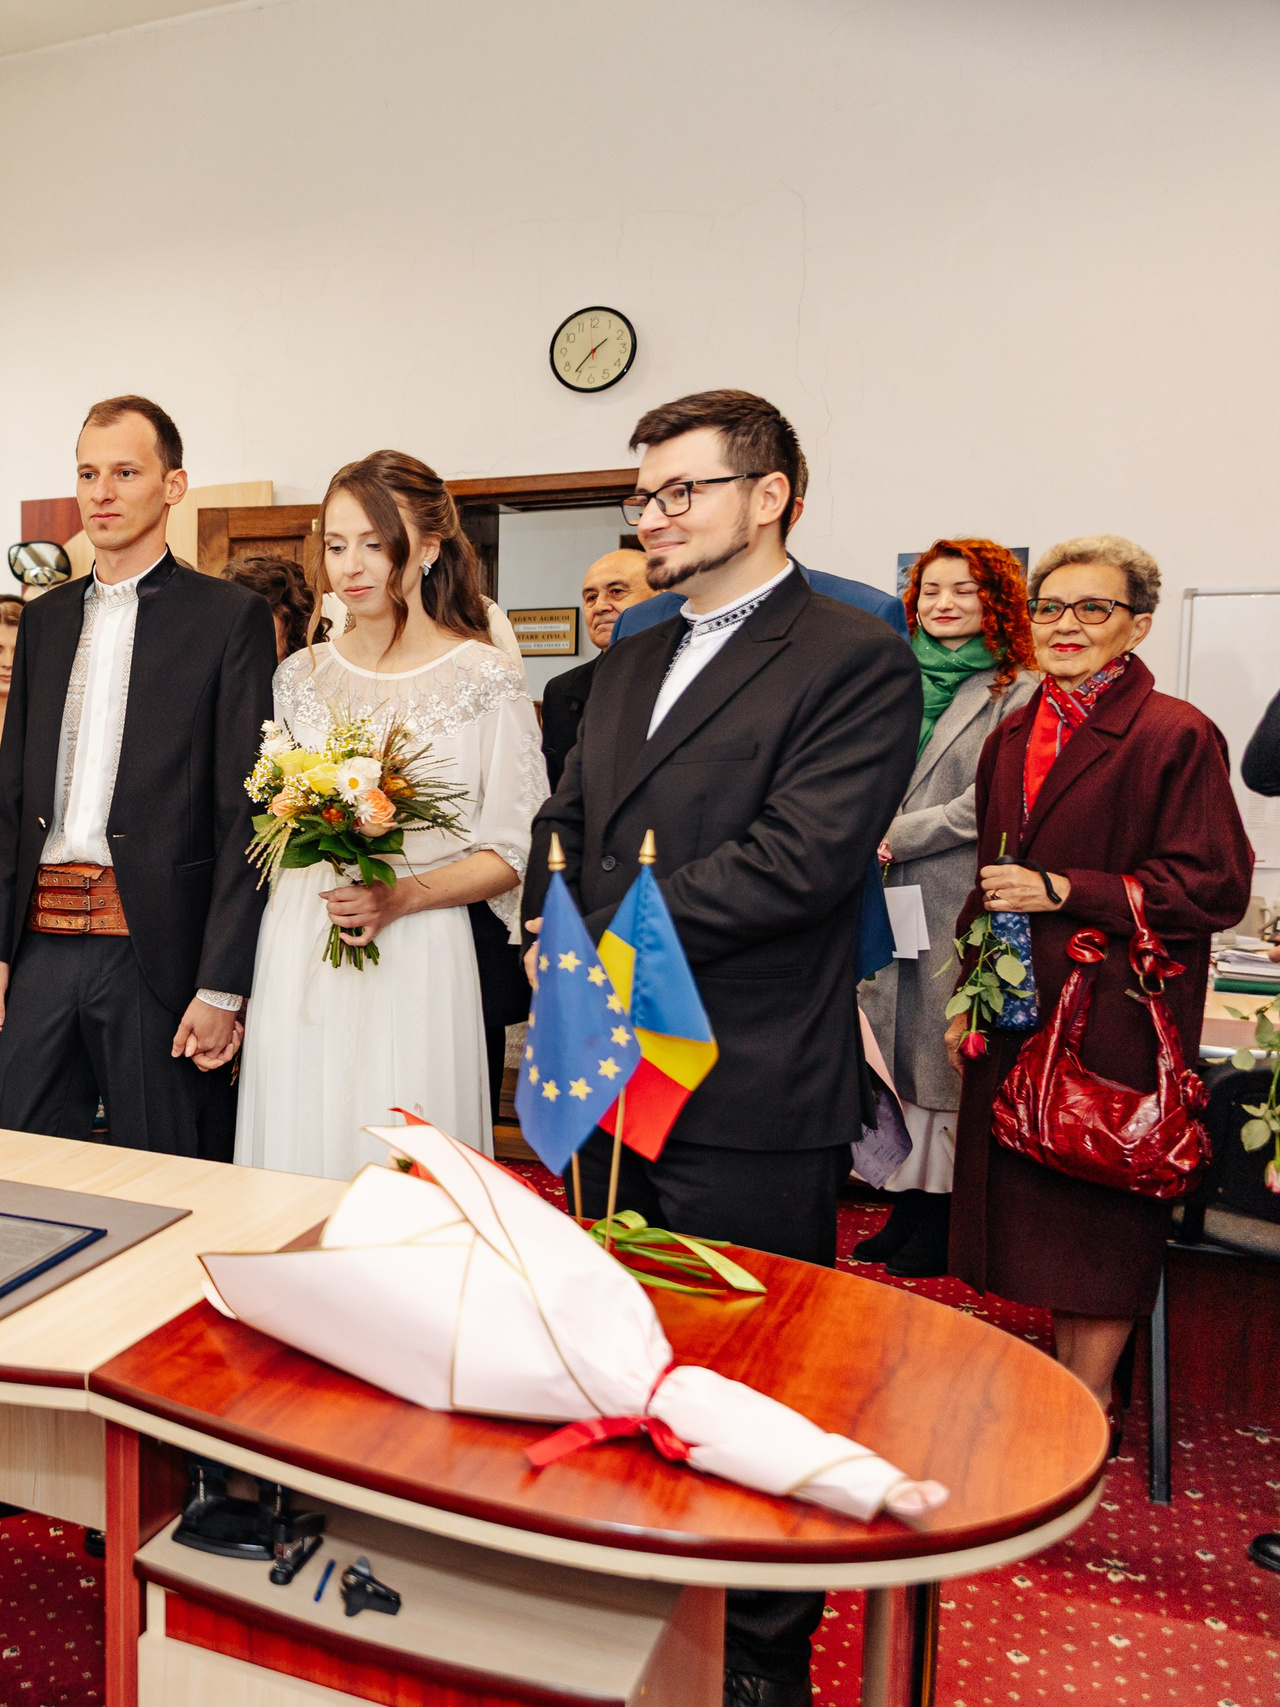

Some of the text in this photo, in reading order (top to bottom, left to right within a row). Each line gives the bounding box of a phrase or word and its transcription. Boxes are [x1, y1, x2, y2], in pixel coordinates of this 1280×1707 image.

[577, 322, 585, 333] 11
[590, 317, 600, 329] 12
[607, 319, 612, 330] 1
[566, 332, 576, 344] 10
[616, 329, 624, 341] 2
[560, 347, 568, 358] 9
[619, 342, 627, 354] 3
[563, 361, 571, 372] 8
[613, 358, 621, 368] 4
[575, 370, 582, 381] 7
[587, 373, 595, 384] 6
[601, 369, 610, 380] 5
